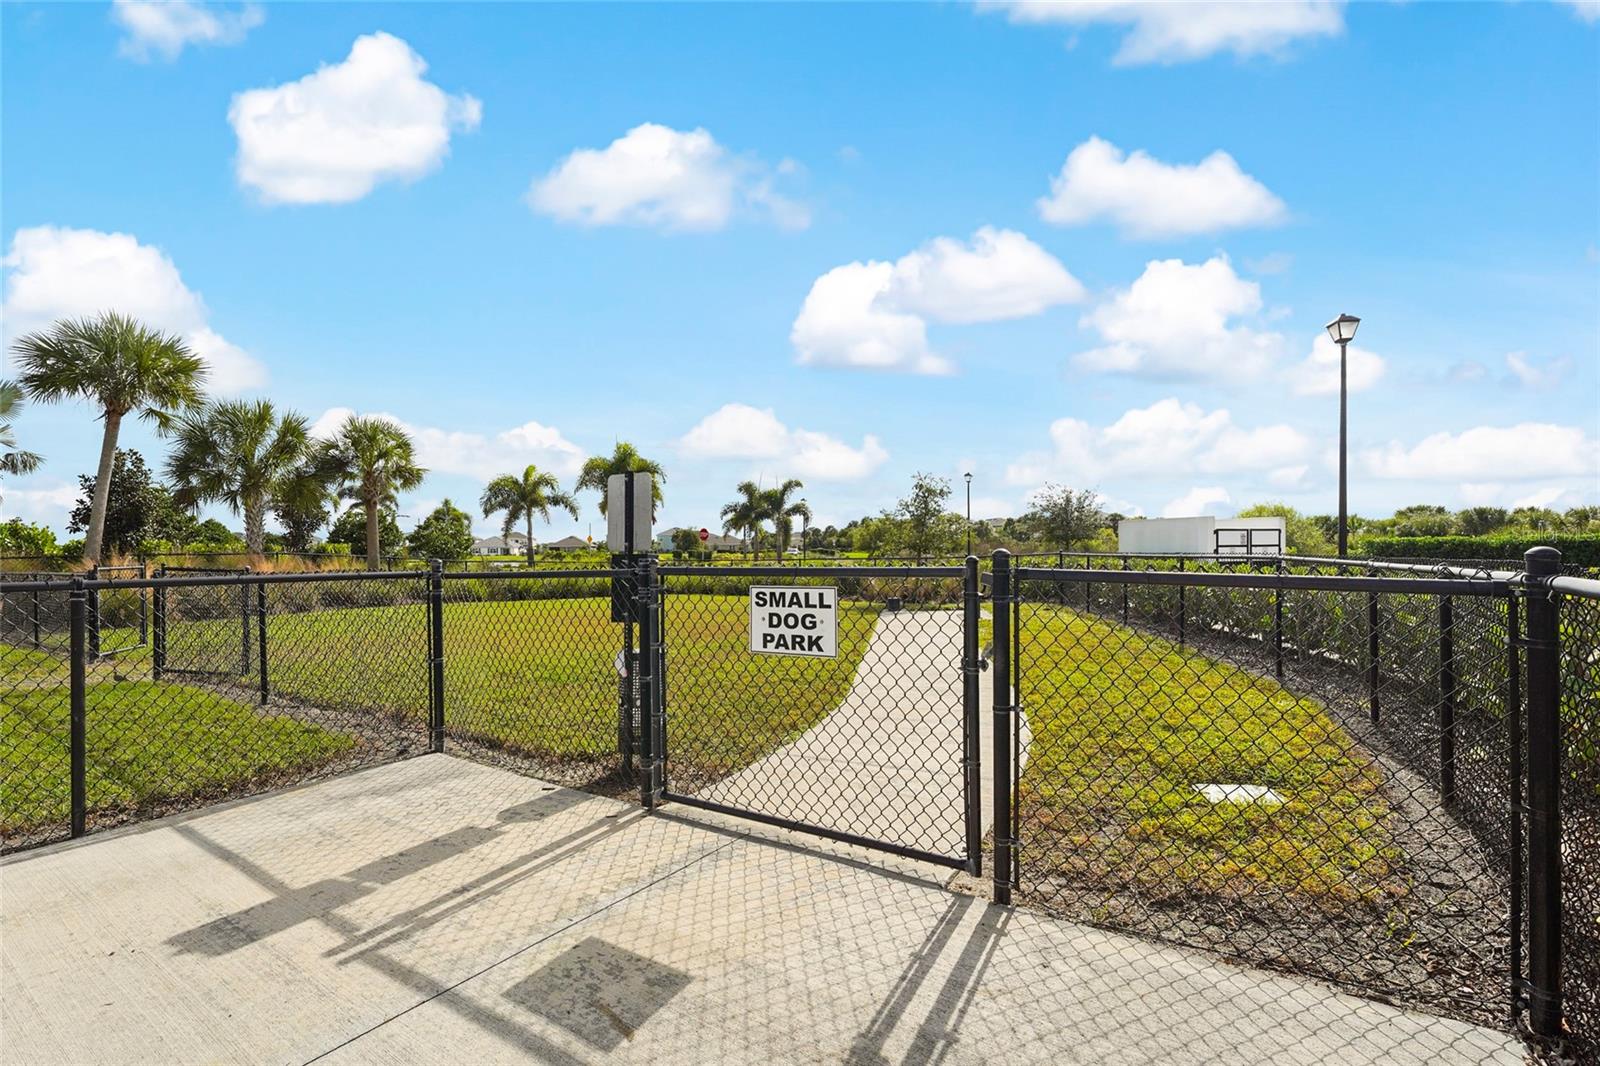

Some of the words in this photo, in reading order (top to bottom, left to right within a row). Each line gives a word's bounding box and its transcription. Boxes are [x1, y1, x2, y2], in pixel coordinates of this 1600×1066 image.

[755, 591, 832, 609] SMALL
[768, 612, 817, 630] DOG
[762, 633, 824, 652] PARK
